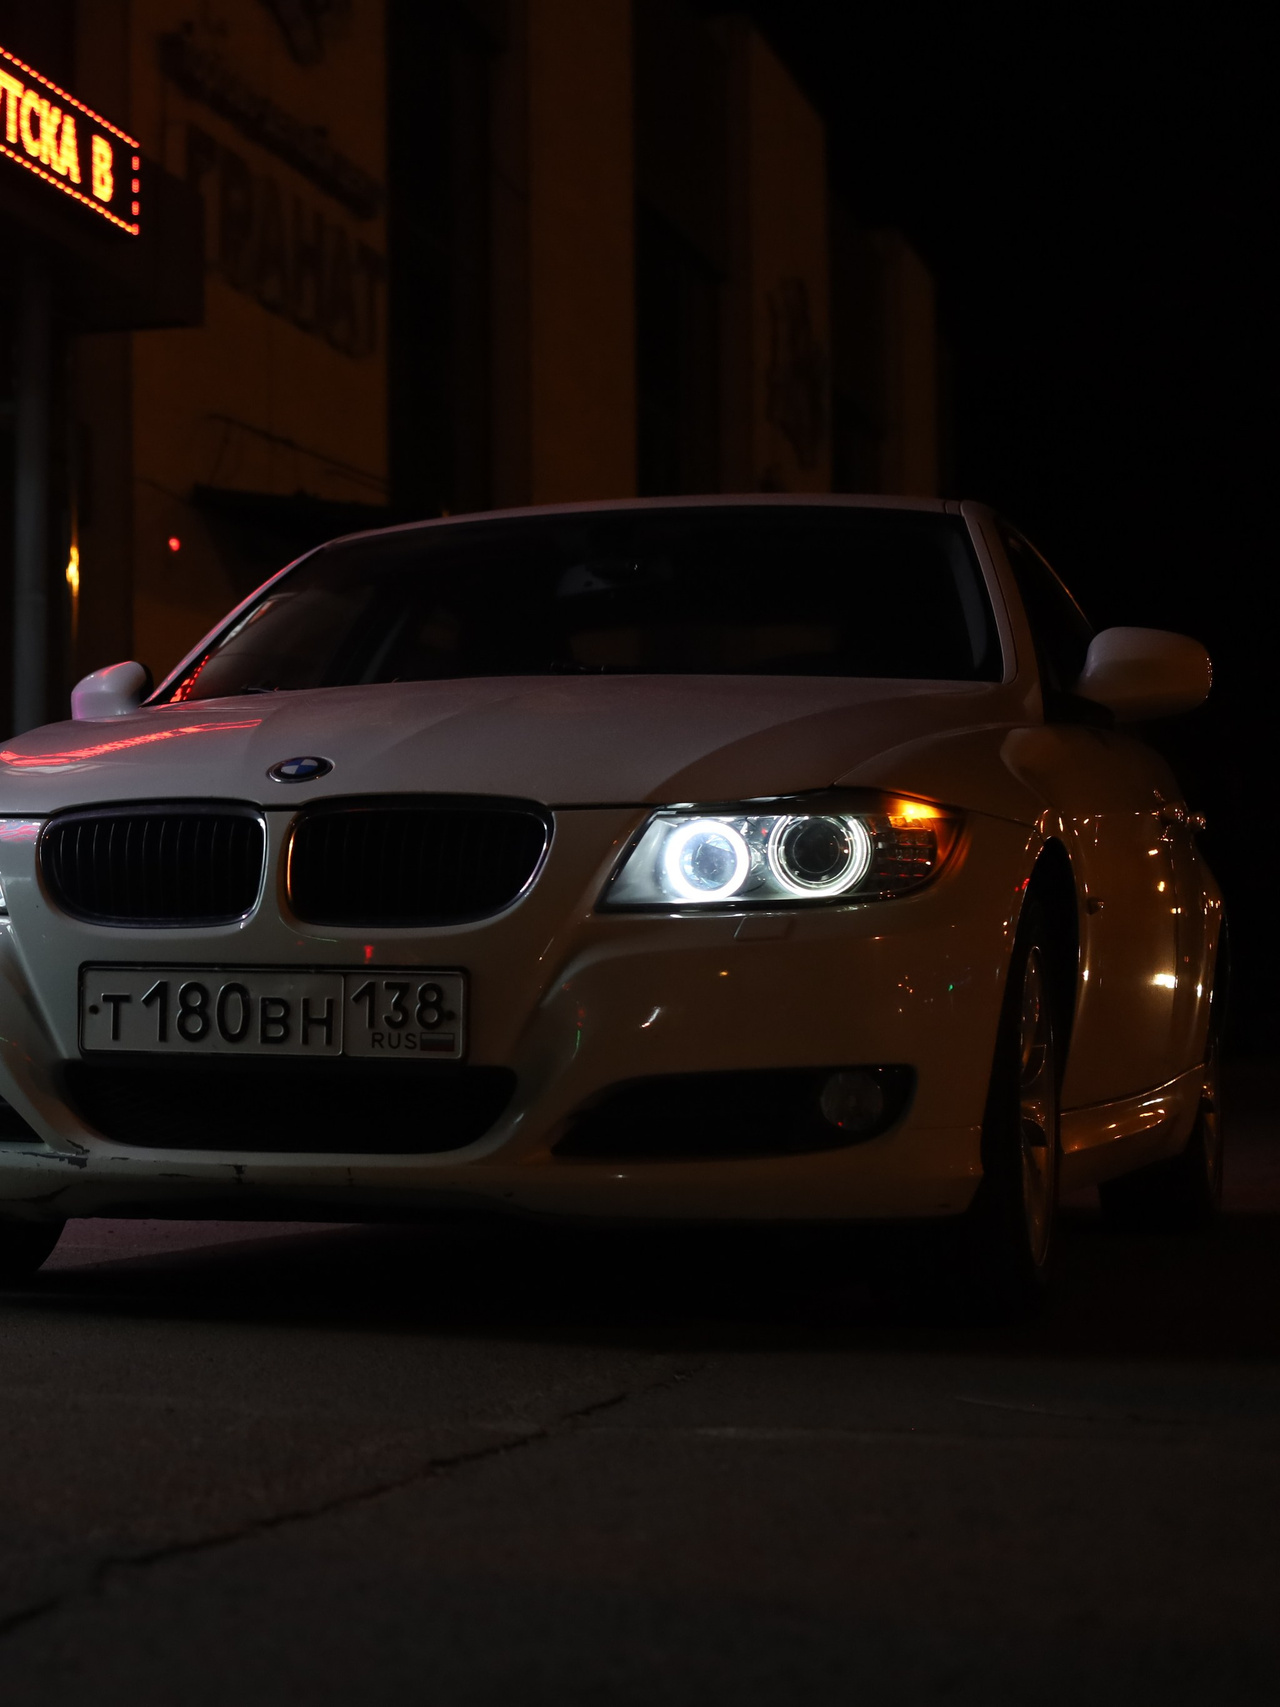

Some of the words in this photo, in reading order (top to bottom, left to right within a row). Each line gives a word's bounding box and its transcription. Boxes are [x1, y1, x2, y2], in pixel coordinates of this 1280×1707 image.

[92, 134, 114, 203] В
[350, 980, 444, 1029] 138
[371, 1032, 418, 1050] RUS
